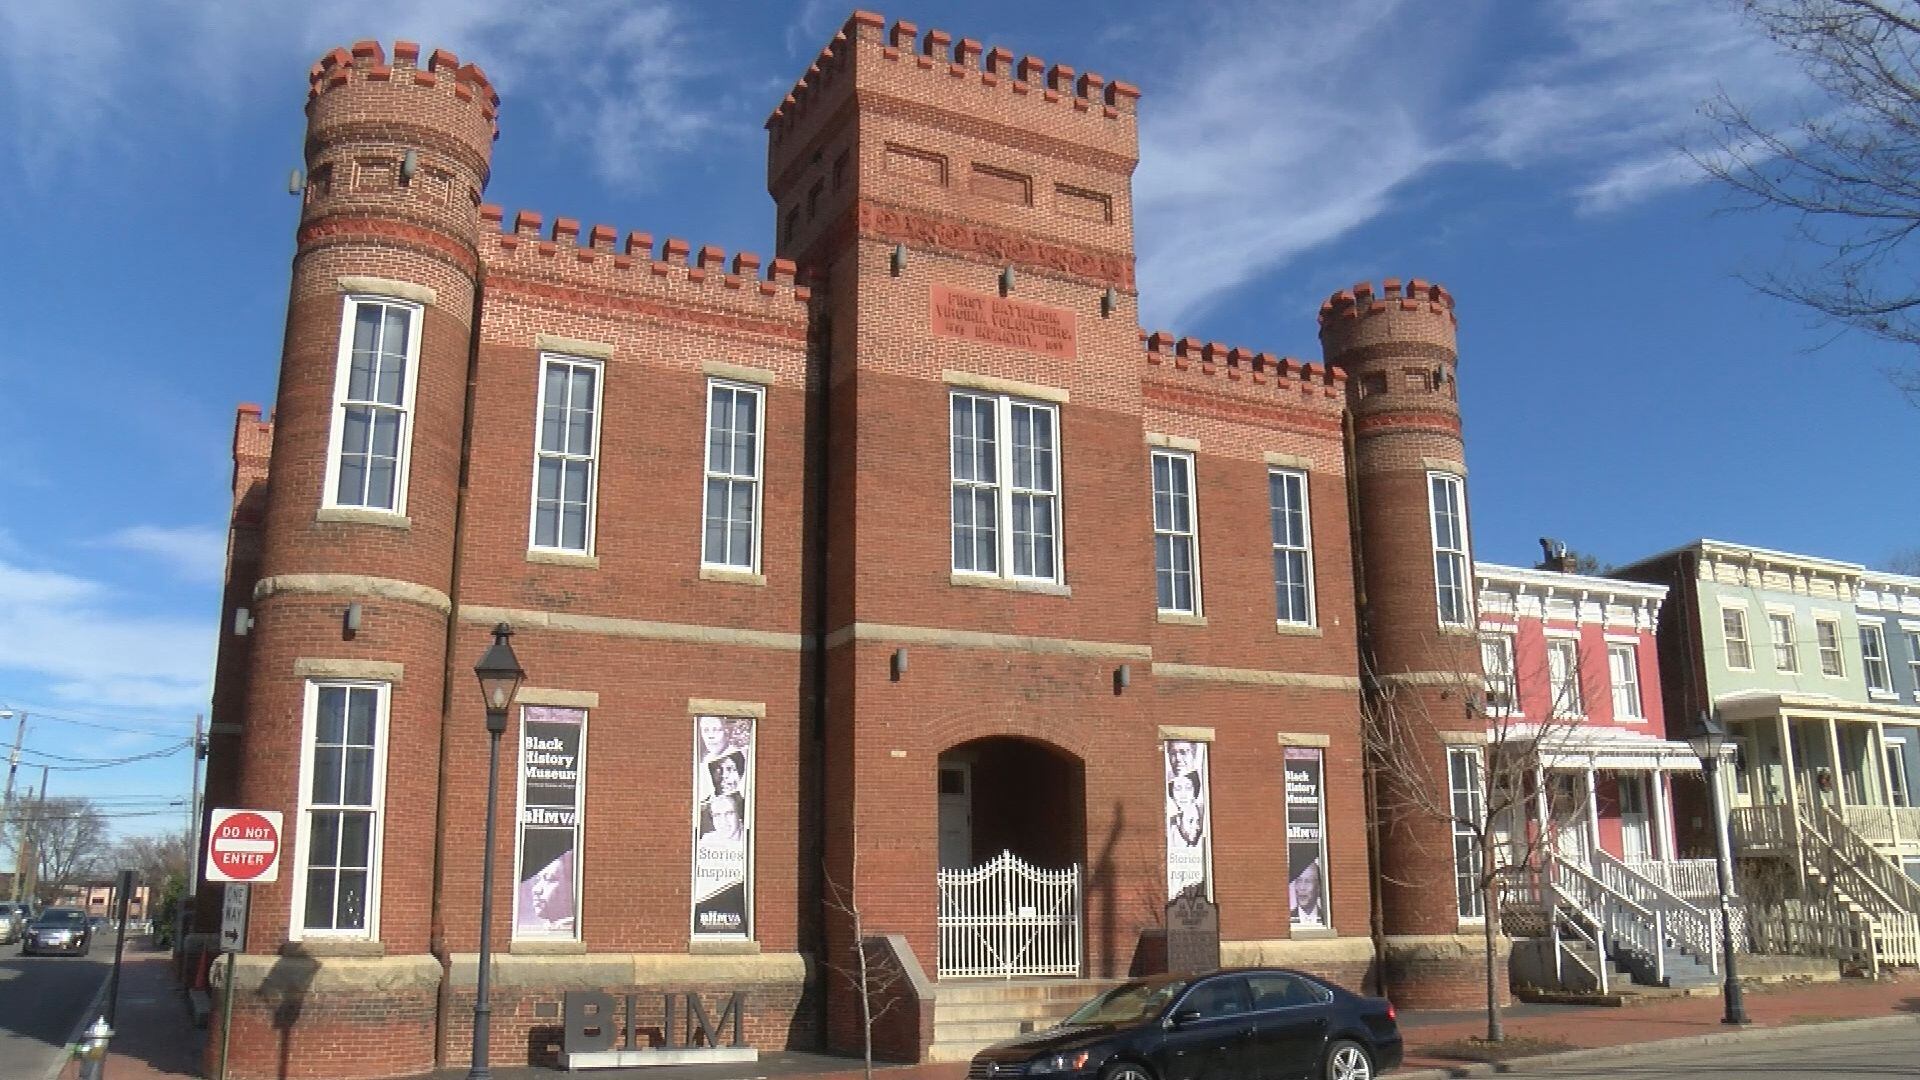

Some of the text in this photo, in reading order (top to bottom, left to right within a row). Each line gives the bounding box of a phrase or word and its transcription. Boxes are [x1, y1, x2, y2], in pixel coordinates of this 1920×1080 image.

[525, 736, 564, 752] Black
[525, 750, 575, 769] History
[222, 826, 270, 839] DO NOT
[223, 852, 264, 866] ENTER
[699, 847, 744, 861] Stories
[697, 865, 741, 881] Inspire
[226, 886, 244, 904] ONE
[225, 906, 243, 922] WAY
